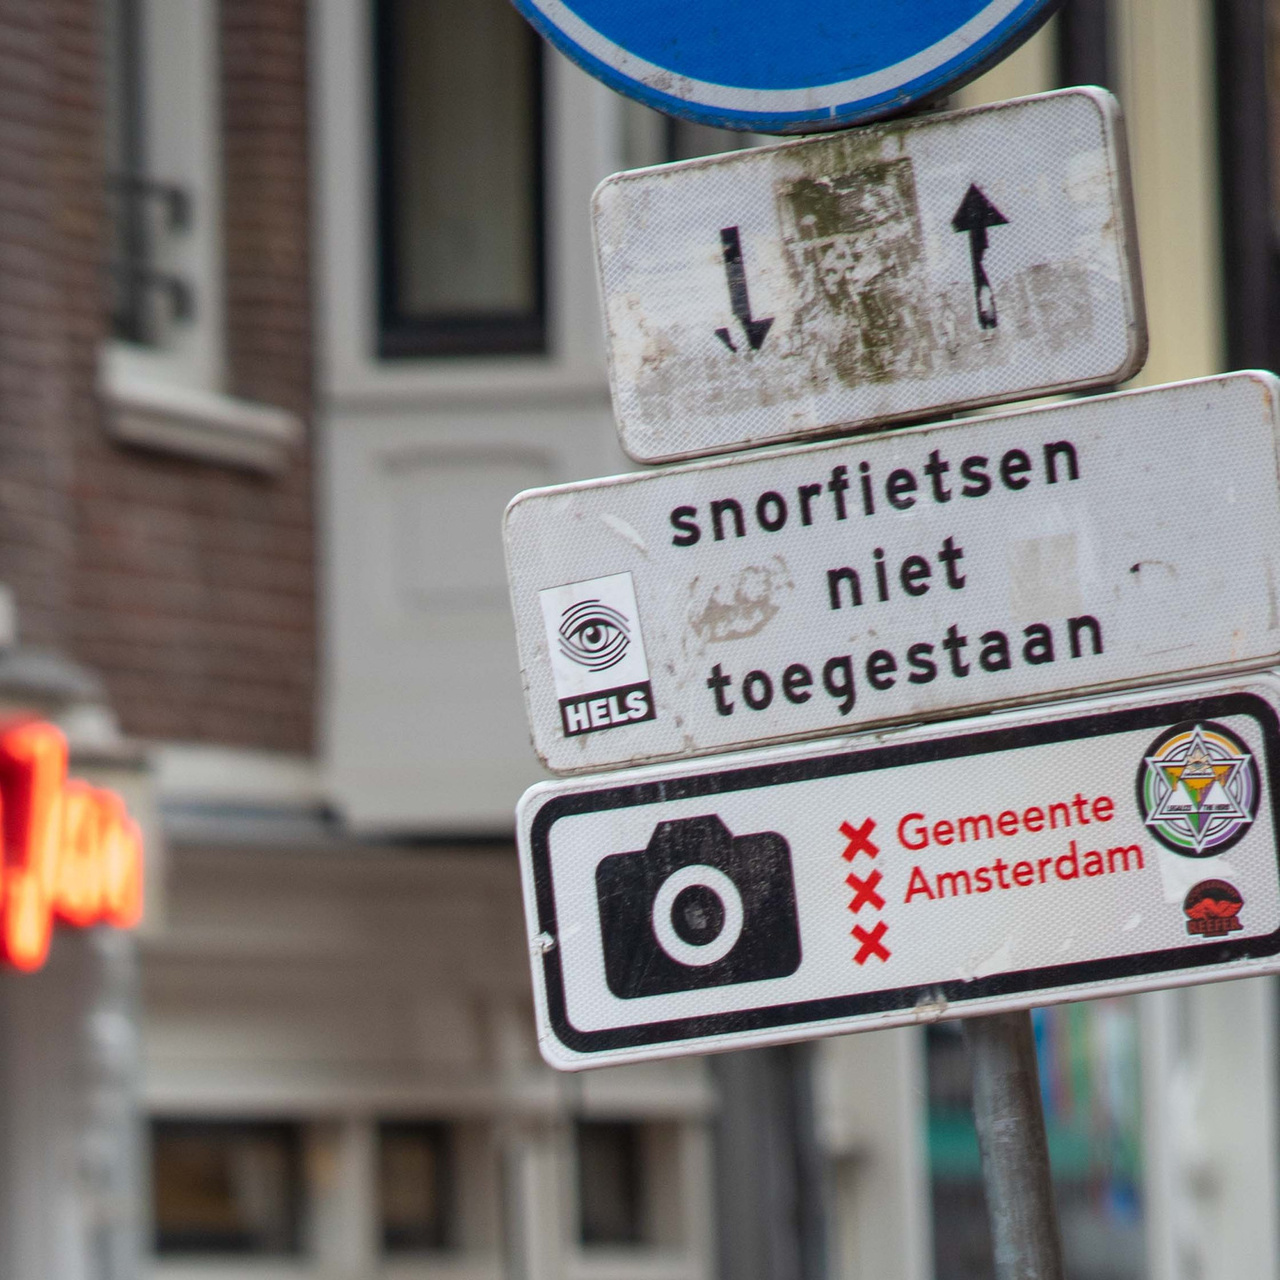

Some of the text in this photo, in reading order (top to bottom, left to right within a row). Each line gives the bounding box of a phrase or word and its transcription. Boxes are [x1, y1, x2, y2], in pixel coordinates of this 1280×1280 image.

[669, 439, 1081, 548] snorfietsen
[825, 535, 967, 611] niet
[705, 614, 1105, 718] toegestaan
[564, 690, 649, 733] HELS
[895, 791, 1117, 852] Gemeente
[903, 839, 1146, 905] Amsterdam
